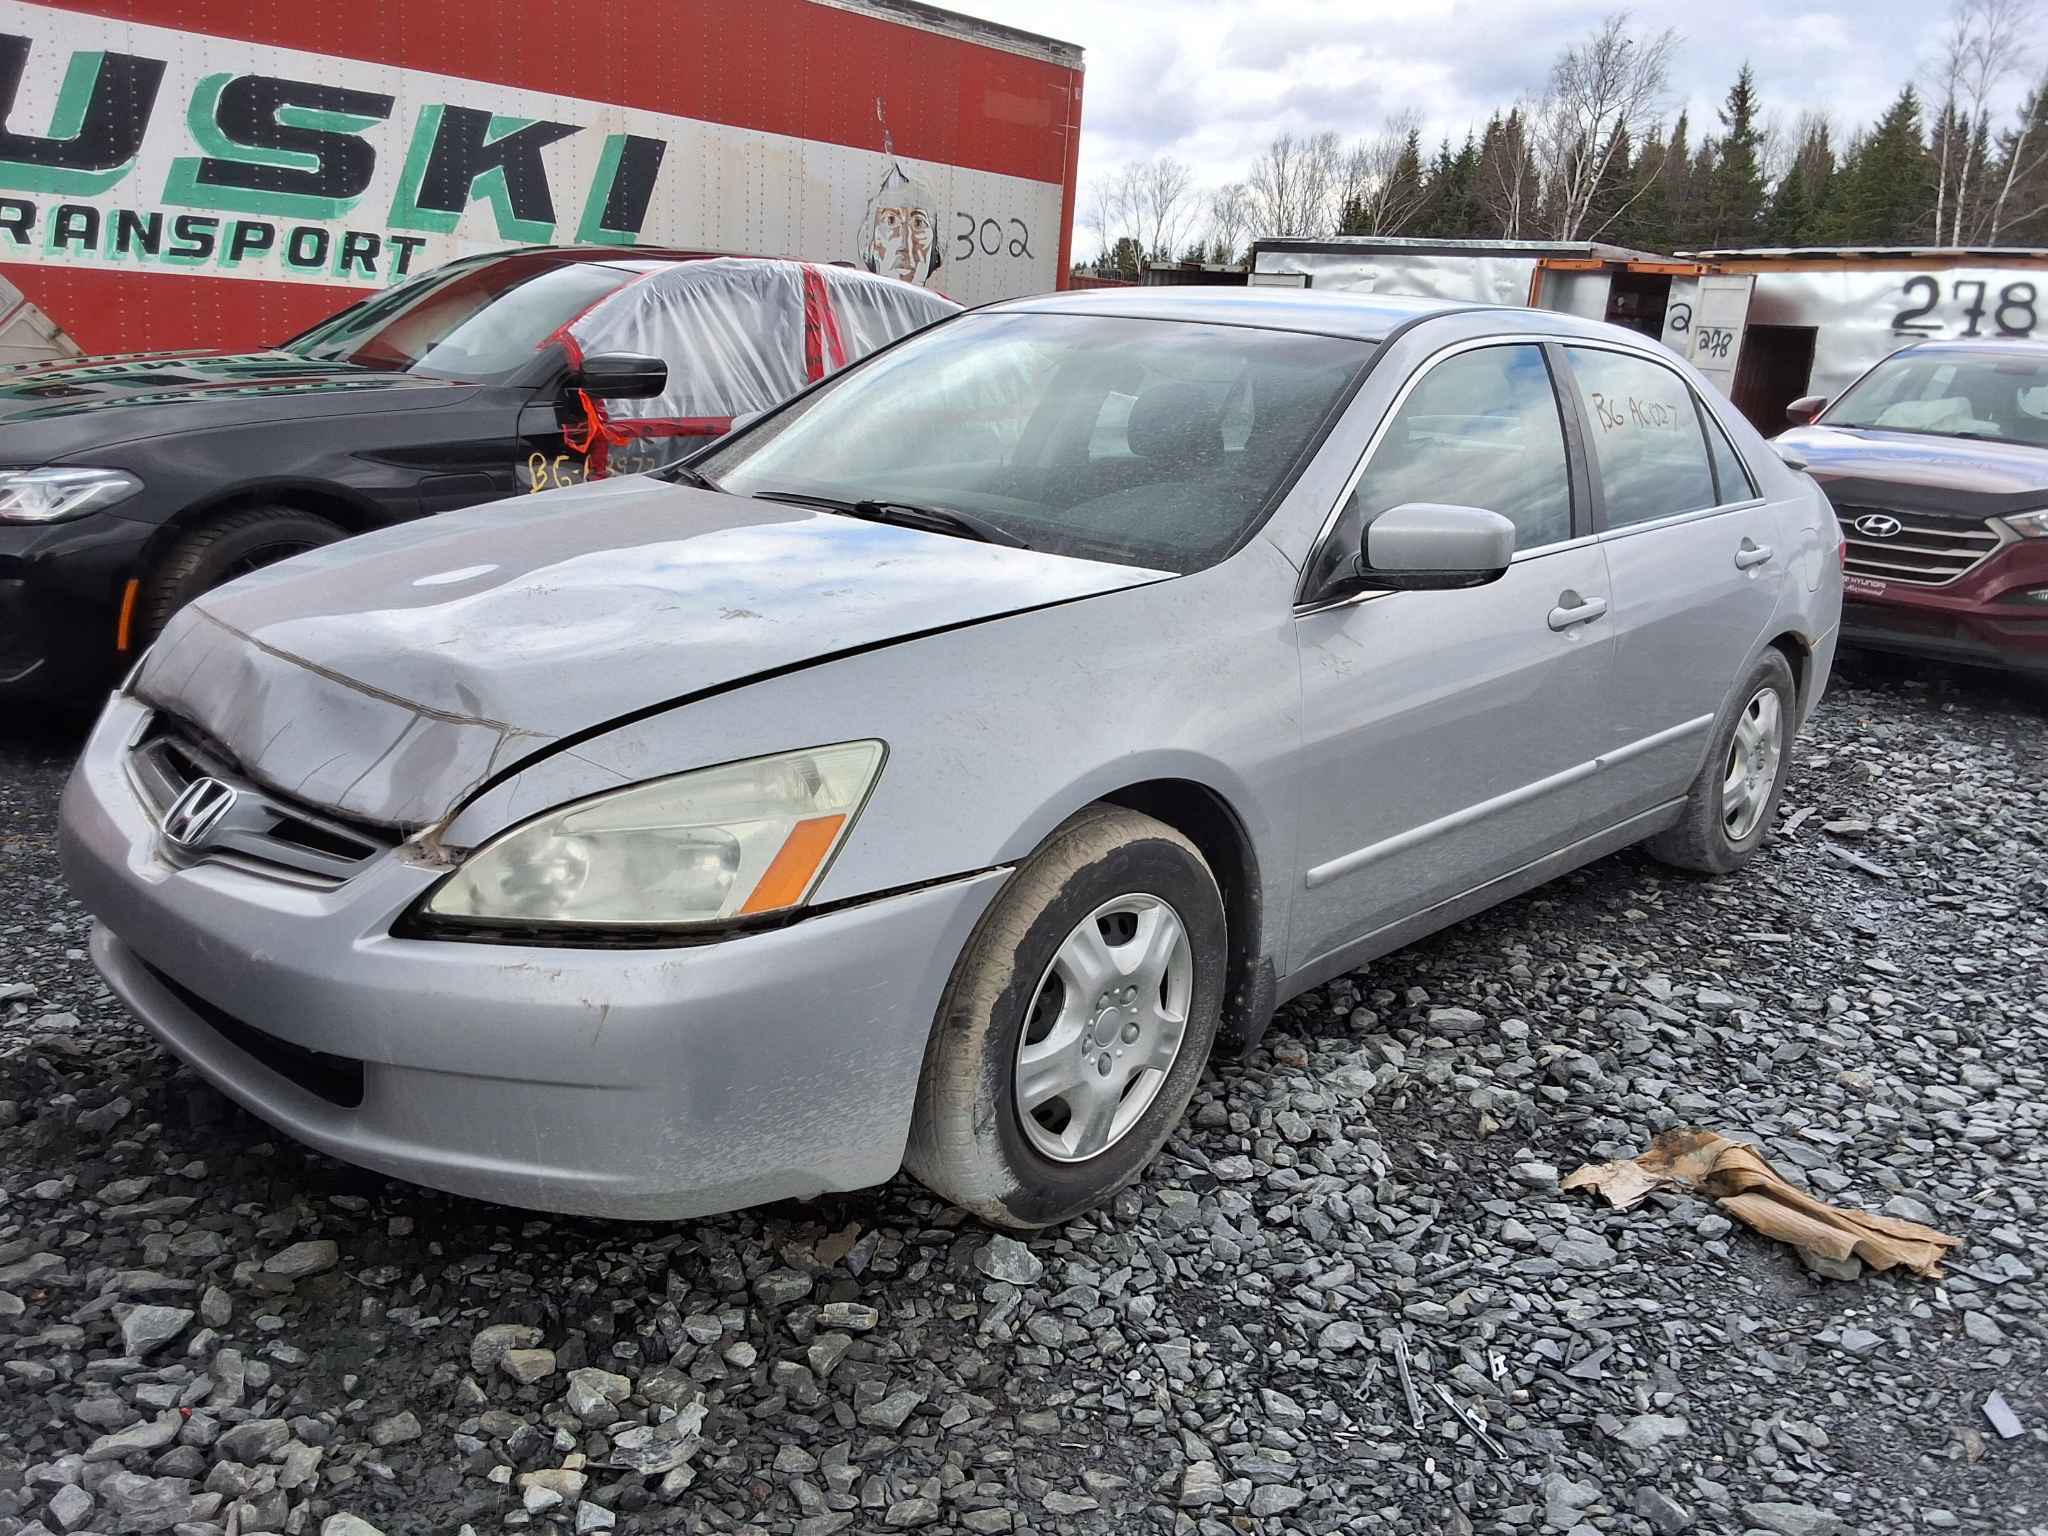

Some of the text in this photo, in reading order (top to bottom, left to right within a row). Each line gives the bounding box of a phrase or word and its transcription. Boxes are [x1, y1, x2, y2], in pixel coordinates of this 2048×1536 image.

[955, 211, 1034, 261] 302
[1891, 275, 2038, 338] 278
[1698, 328, 1733, 358] 278
